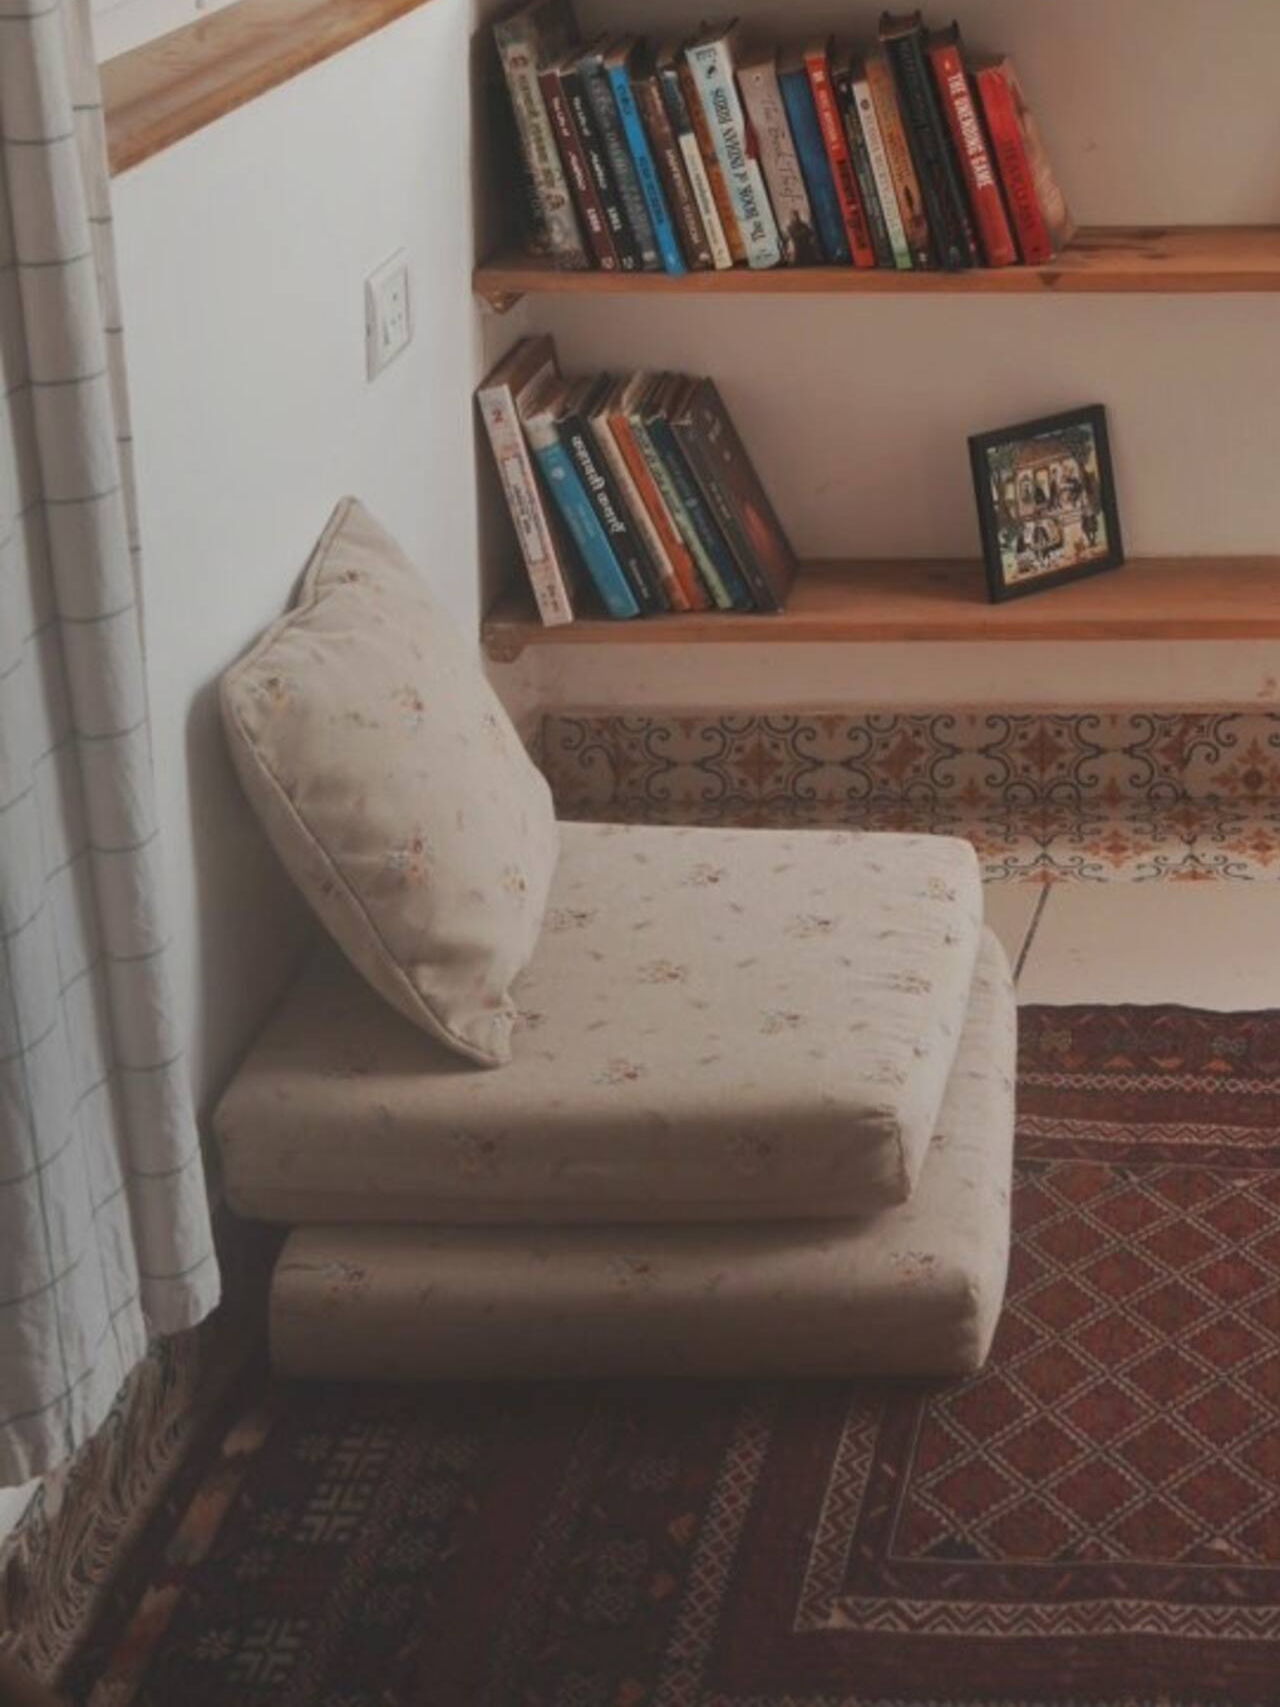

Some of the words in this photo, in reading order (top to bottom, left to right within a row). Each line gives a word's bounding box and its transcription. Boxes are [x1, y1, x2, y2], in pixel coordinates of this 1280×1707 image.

[708, 86, 732, 125] BIRDS
[720, 125, 746, 170] INDIAN
[946, 71, 967, 95] THE
[969, 154, 994, 190] GAME
[737, 184, 760, 219] BOOK
[747, 219, 766, 242] The
